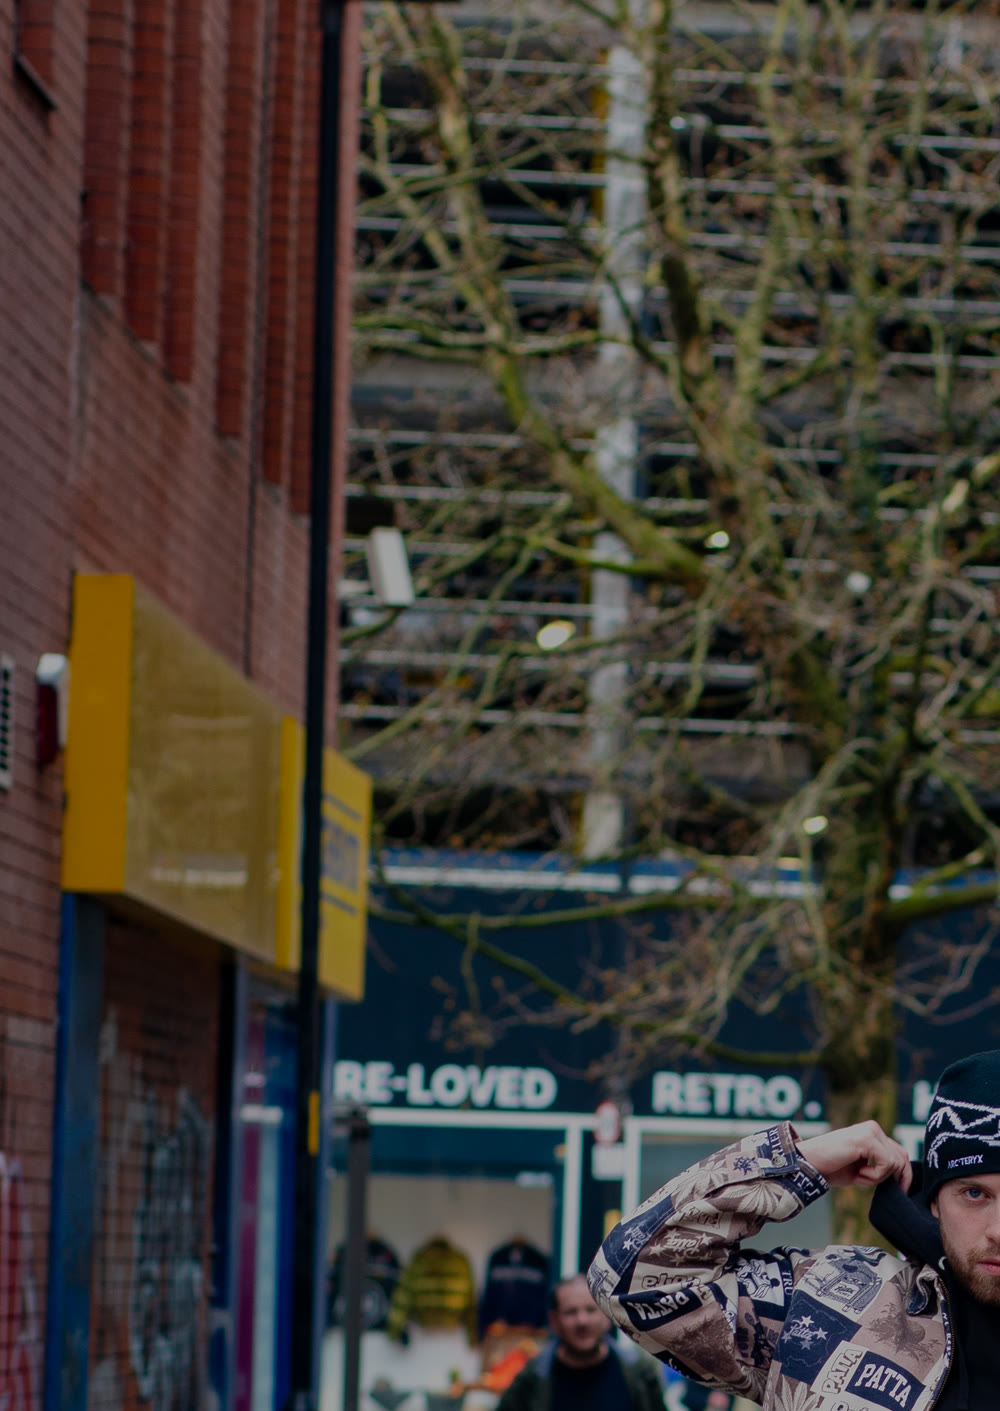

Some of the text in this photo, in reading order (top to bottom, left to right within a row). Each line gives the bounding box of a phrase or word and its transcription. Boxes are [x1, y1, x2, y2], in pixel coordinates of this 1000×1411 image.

[334, 1060, 558, 1109] RE-LOVED
[782, 1271, 792, 1295] TRU
[627, 1291, 690, 1320] PATTA
[790, 1318, 816, 1341] Patta
[822, 1348, 863, 1394] PATTA
[854, 1363, 912, 1408] PATTA
